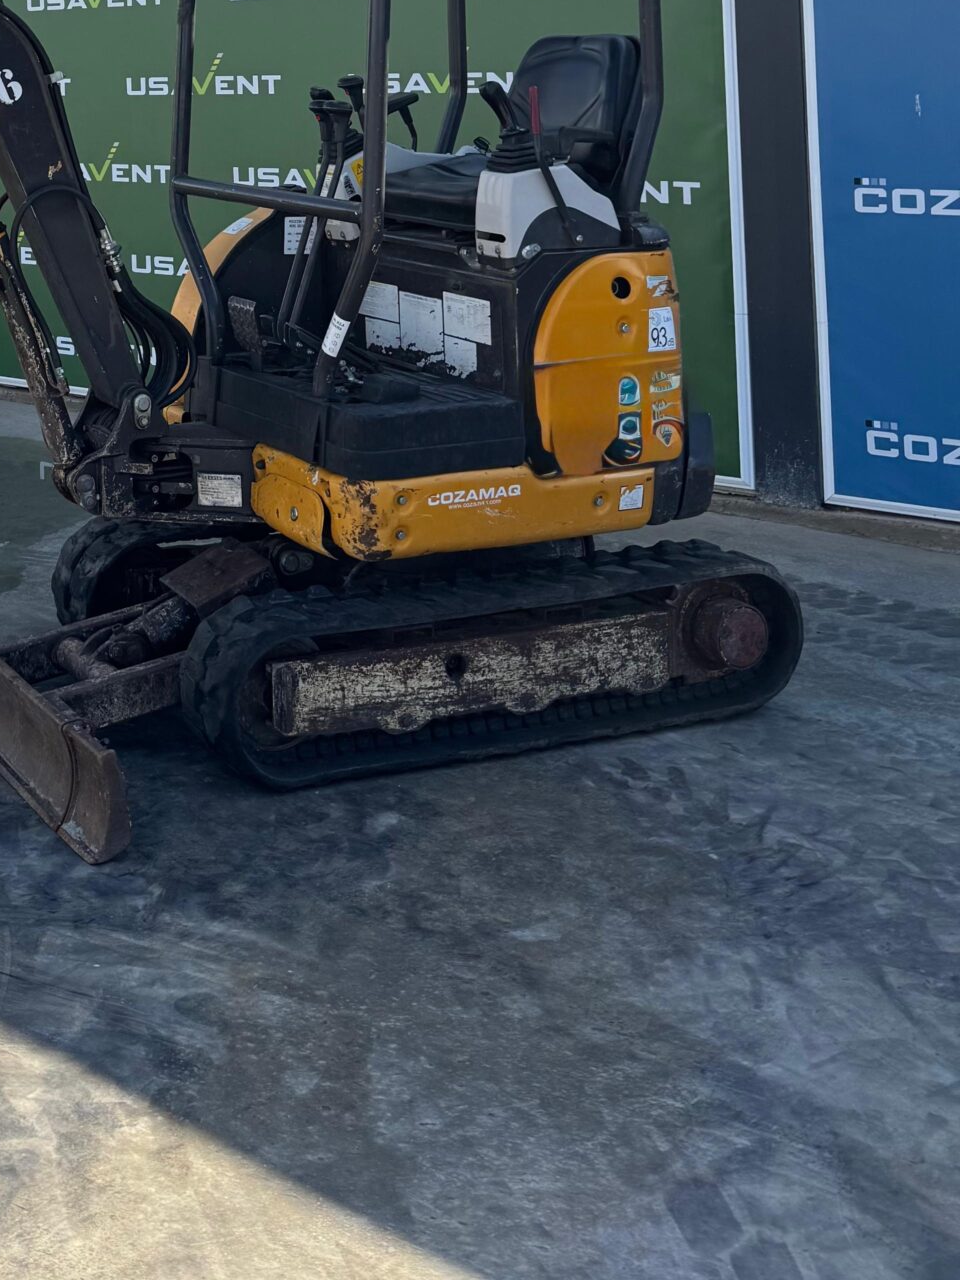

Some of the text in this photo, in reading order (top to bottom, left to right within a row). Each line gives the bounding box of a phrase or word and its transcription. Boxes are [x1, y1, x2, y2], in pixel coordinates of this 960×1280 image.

[126, 72, 281, 96] USVENT
[362, 71, 514, 94] SAVEN
[651, 326, 668, 348] 93
[428, 484, 521, 506] COZAMAQ
